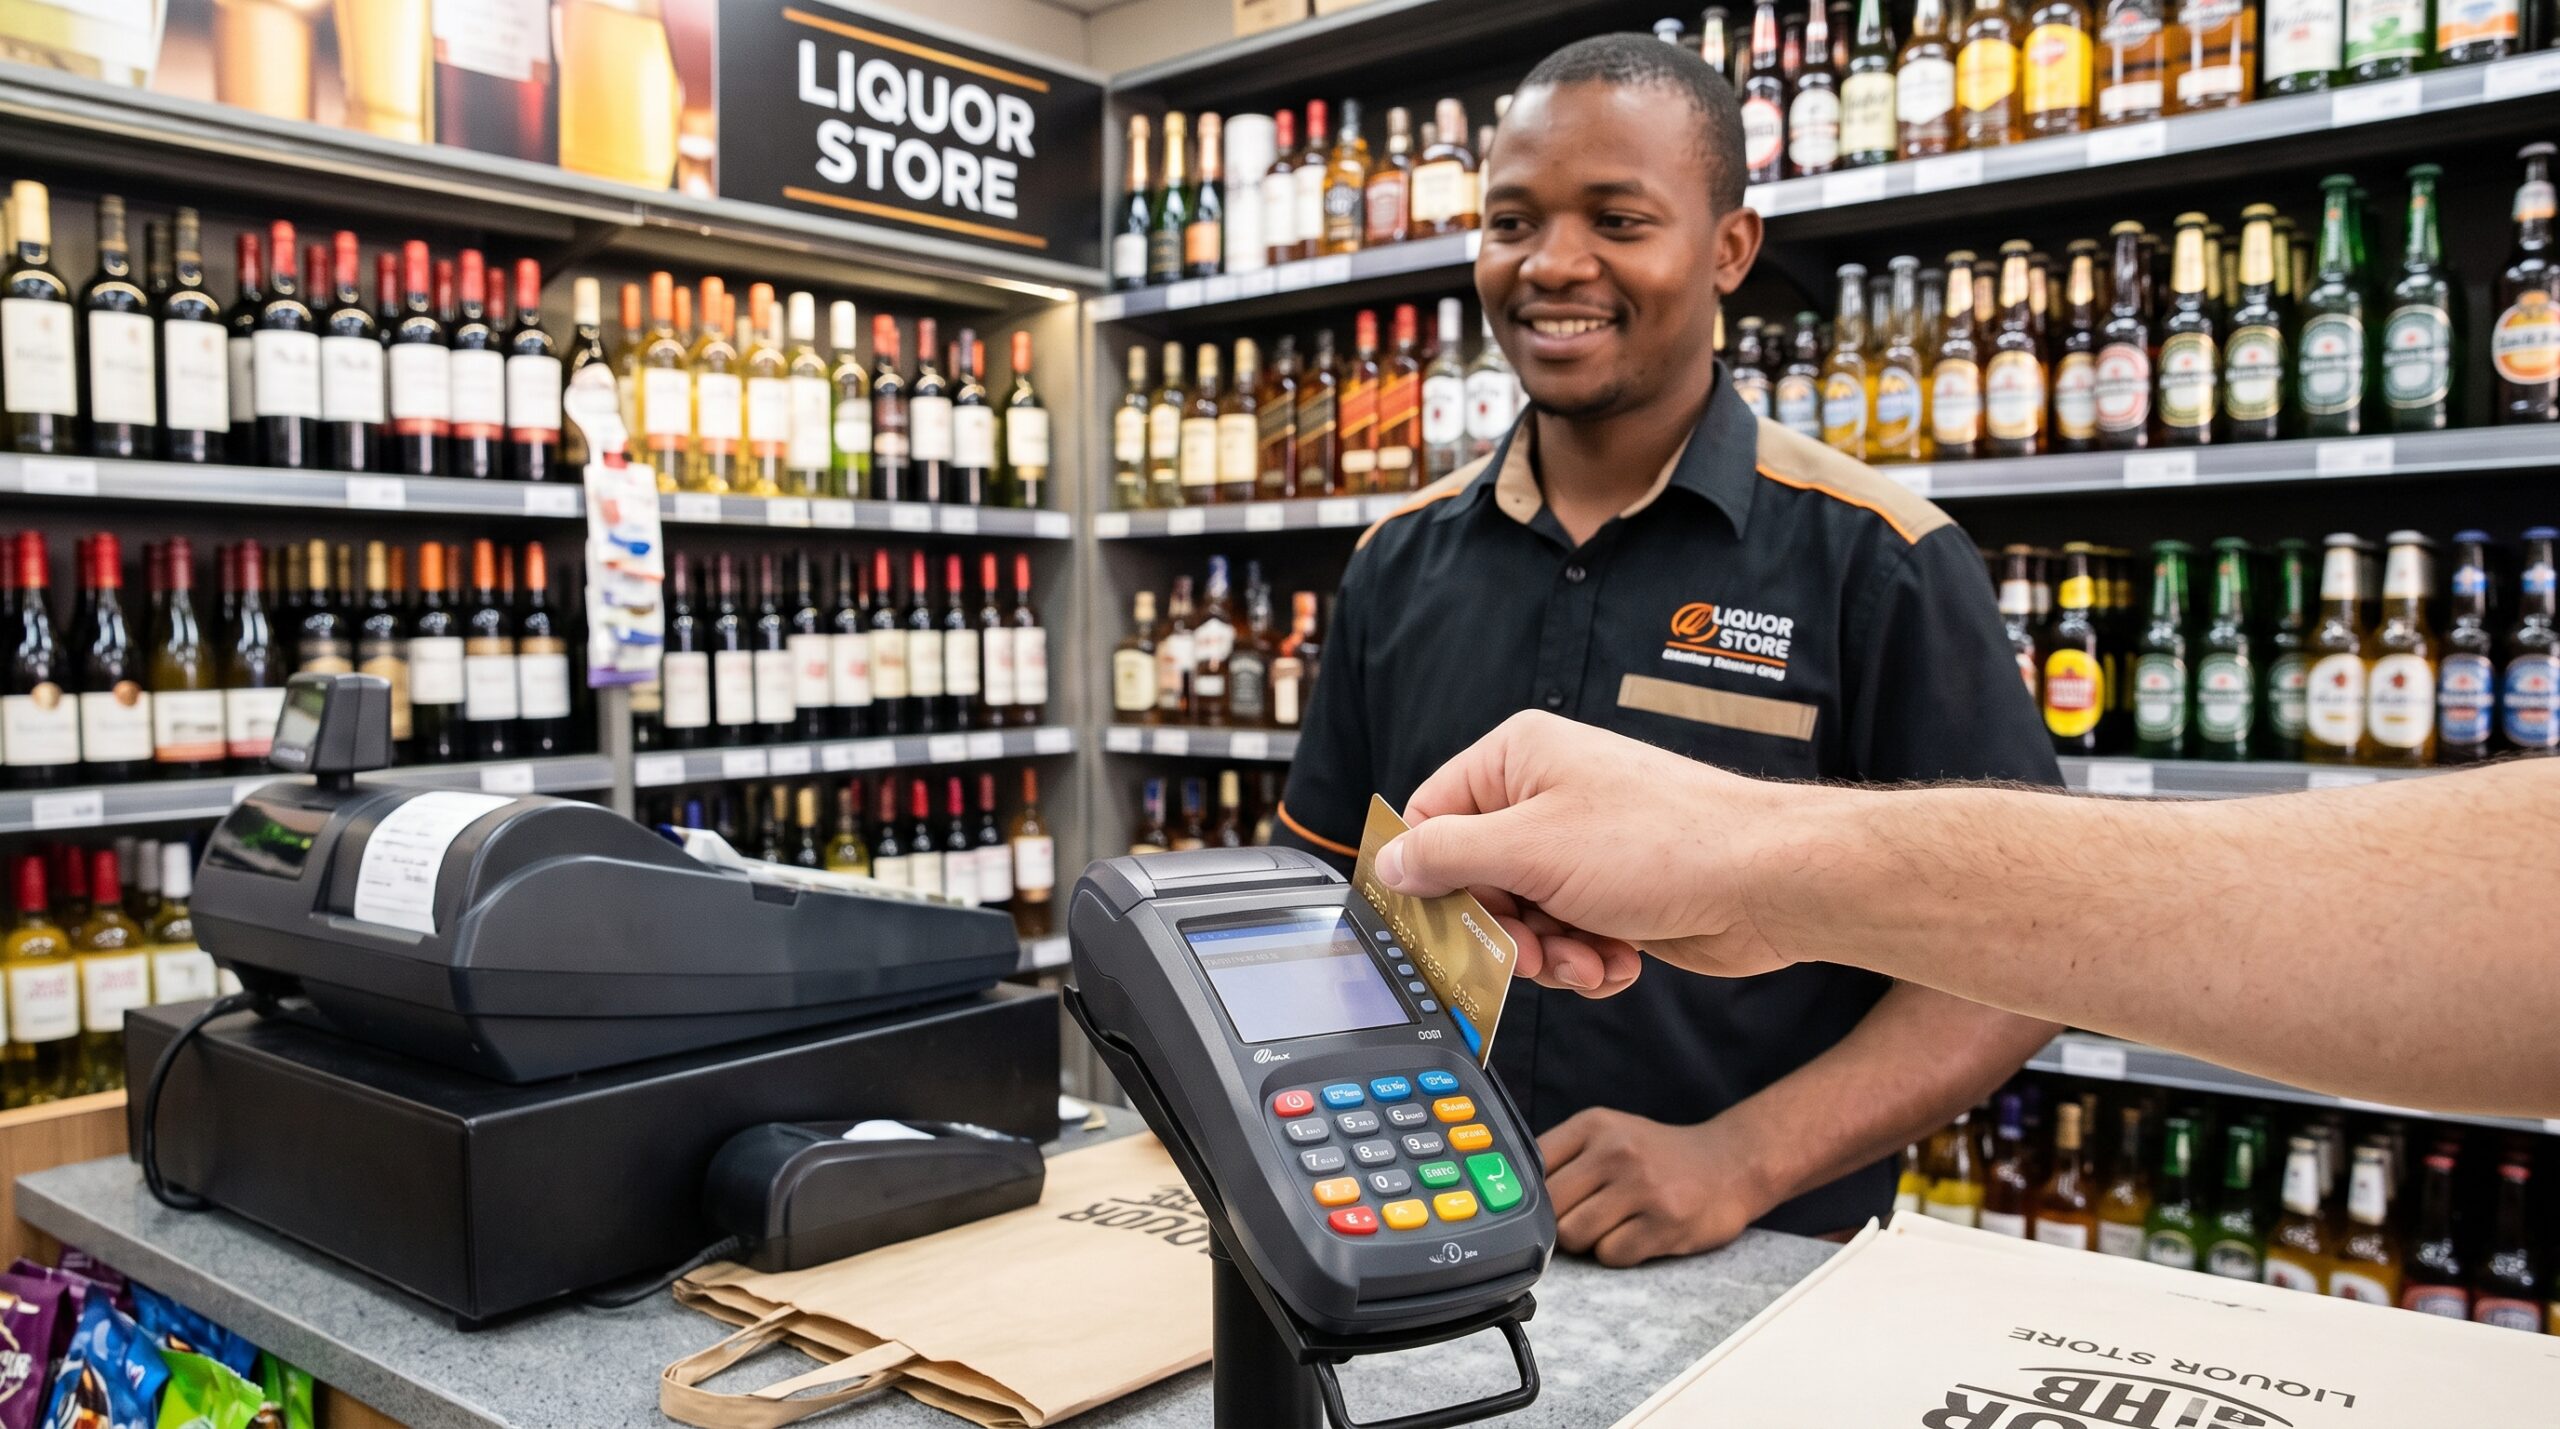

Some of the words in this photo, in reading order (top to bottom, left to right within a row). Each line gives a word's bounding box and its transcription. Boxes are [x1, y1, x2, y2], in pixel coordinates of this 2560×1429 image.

[799, 39, 1036, 158] LIQUOR
[815, 119, 1018, 219] STORE
[1712, 605, 1794, 638] LIQUOR
[1719, 628, 1791, 659] STORE
[1392, 1110, 1404, 1121] 6
[1292, 1124, 1303, 1136] 1
[1343, 1117, 1356, 1129] 5
[1408, 1138, 1420, 1149] 9
[1360, 1146, 1372, 1158] 8
[1306, 1154, 1317, 1166] 7
[1375, 1175, 1389, 1189] 0
[2009, 1327, 2157, 1366] STORE
[2170, 1359, 2356, 1408] LIQUOR
